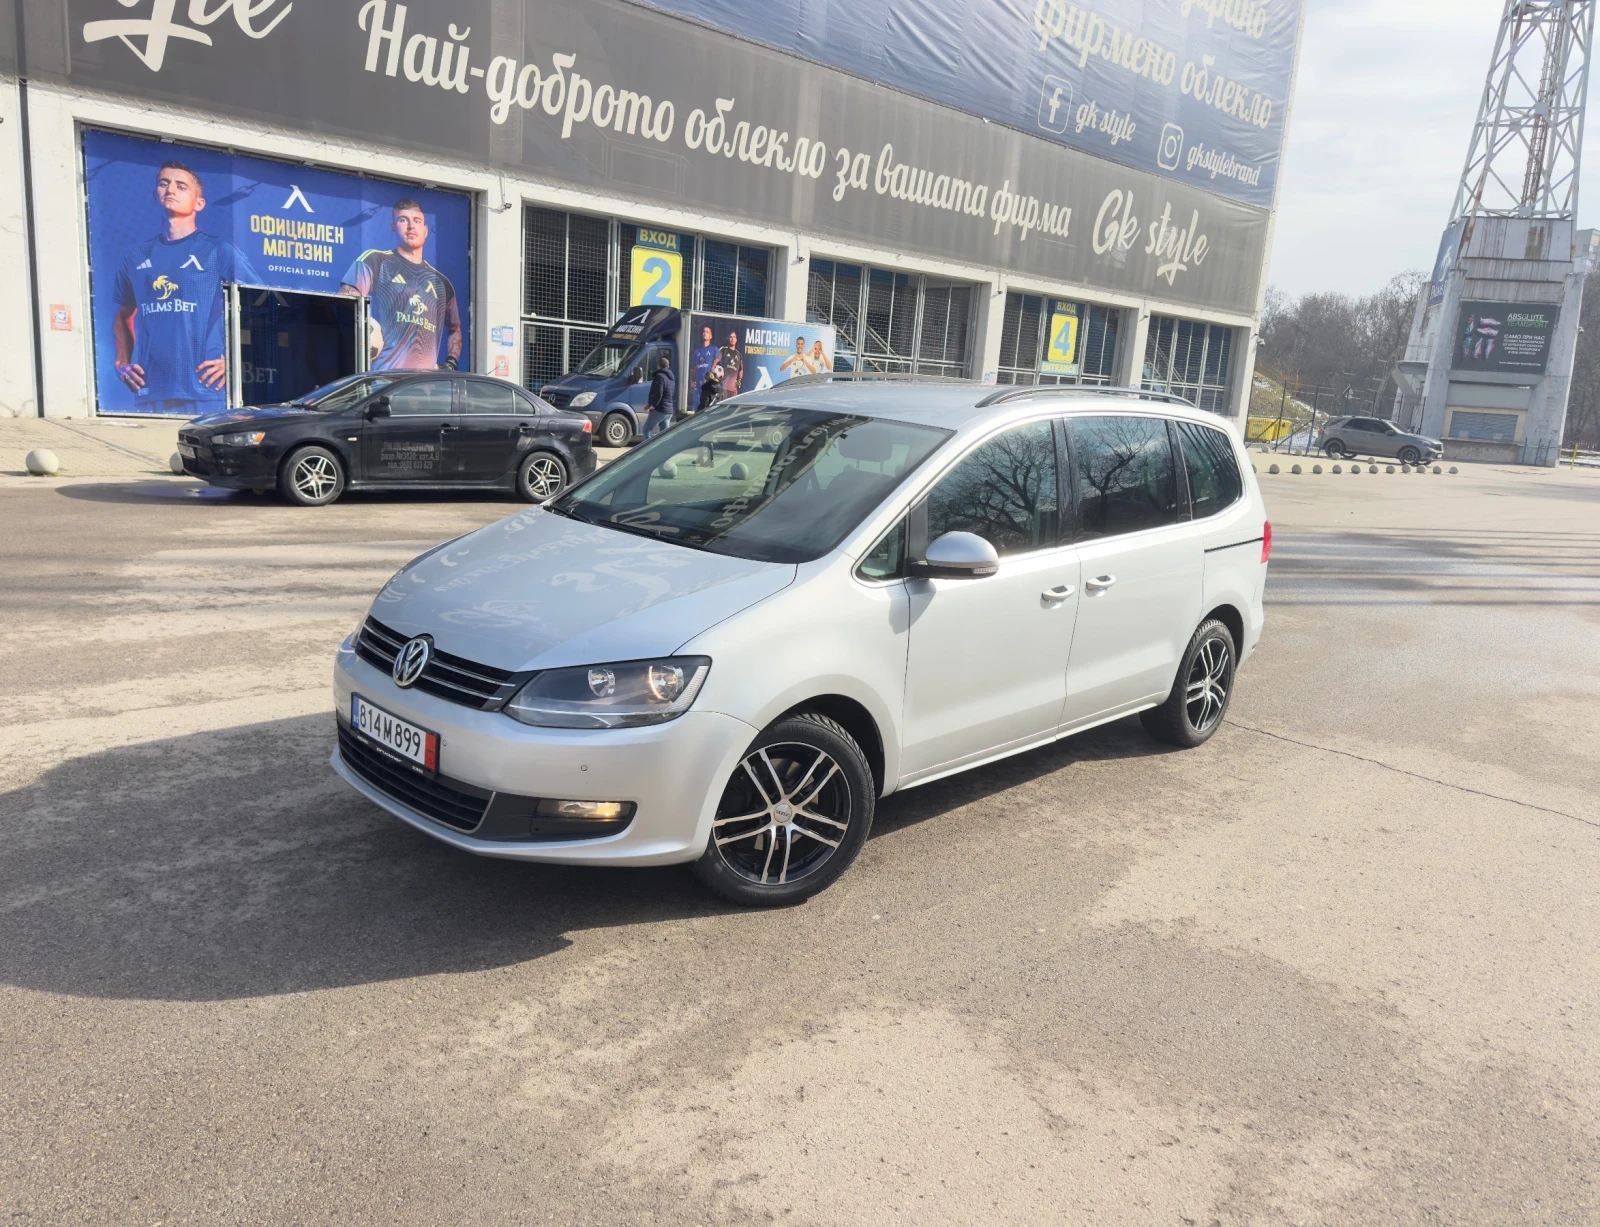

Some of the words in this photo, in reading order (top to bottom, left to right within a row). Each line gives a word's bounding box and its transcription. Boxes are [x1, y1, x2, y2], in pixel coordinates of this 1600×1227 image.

[1035, 0, 1177, 86] фирмено
[1180, 54, 1273, 129] облекло
[358, 0, 675, 142] Най-доброто
[685, 97, 826, 178] облекло
[832, 147, 871, 201] за
[875, 143, 989, 218] вашата
[991, 178, 1073, 242] фирма
[1075, 100, 1098, 133] gk
[1099, 109, 1137, 146] style
[1186, 143, 1262, 186] gkstylebrand
[250, 214, 344, 245] ОФИЦИАЛЕН
[639, 228, 677, 250] ВХОД
[1092, 188, 1142, 255] Gk
[1145, 201, 1210, 287] style
[263, 237, 333, 264] МАГАЗИН
[268, 264, 305, 275] OFFICIAL
[307, 269, 330, 278] STORE
[640, 256, 672, 307] 2
[1057, 302, 1077, 315] ВХОД
[1508, 313, 1545, 322] ABSOLUTE
[745, 328, 791, 347] МАГАЗИН
[1054, 320, 1071, 357] 4
[1508, 321, 1549, 329] TEAMSPORT
[1041, 362, 1077, 375] ENTRANCE
